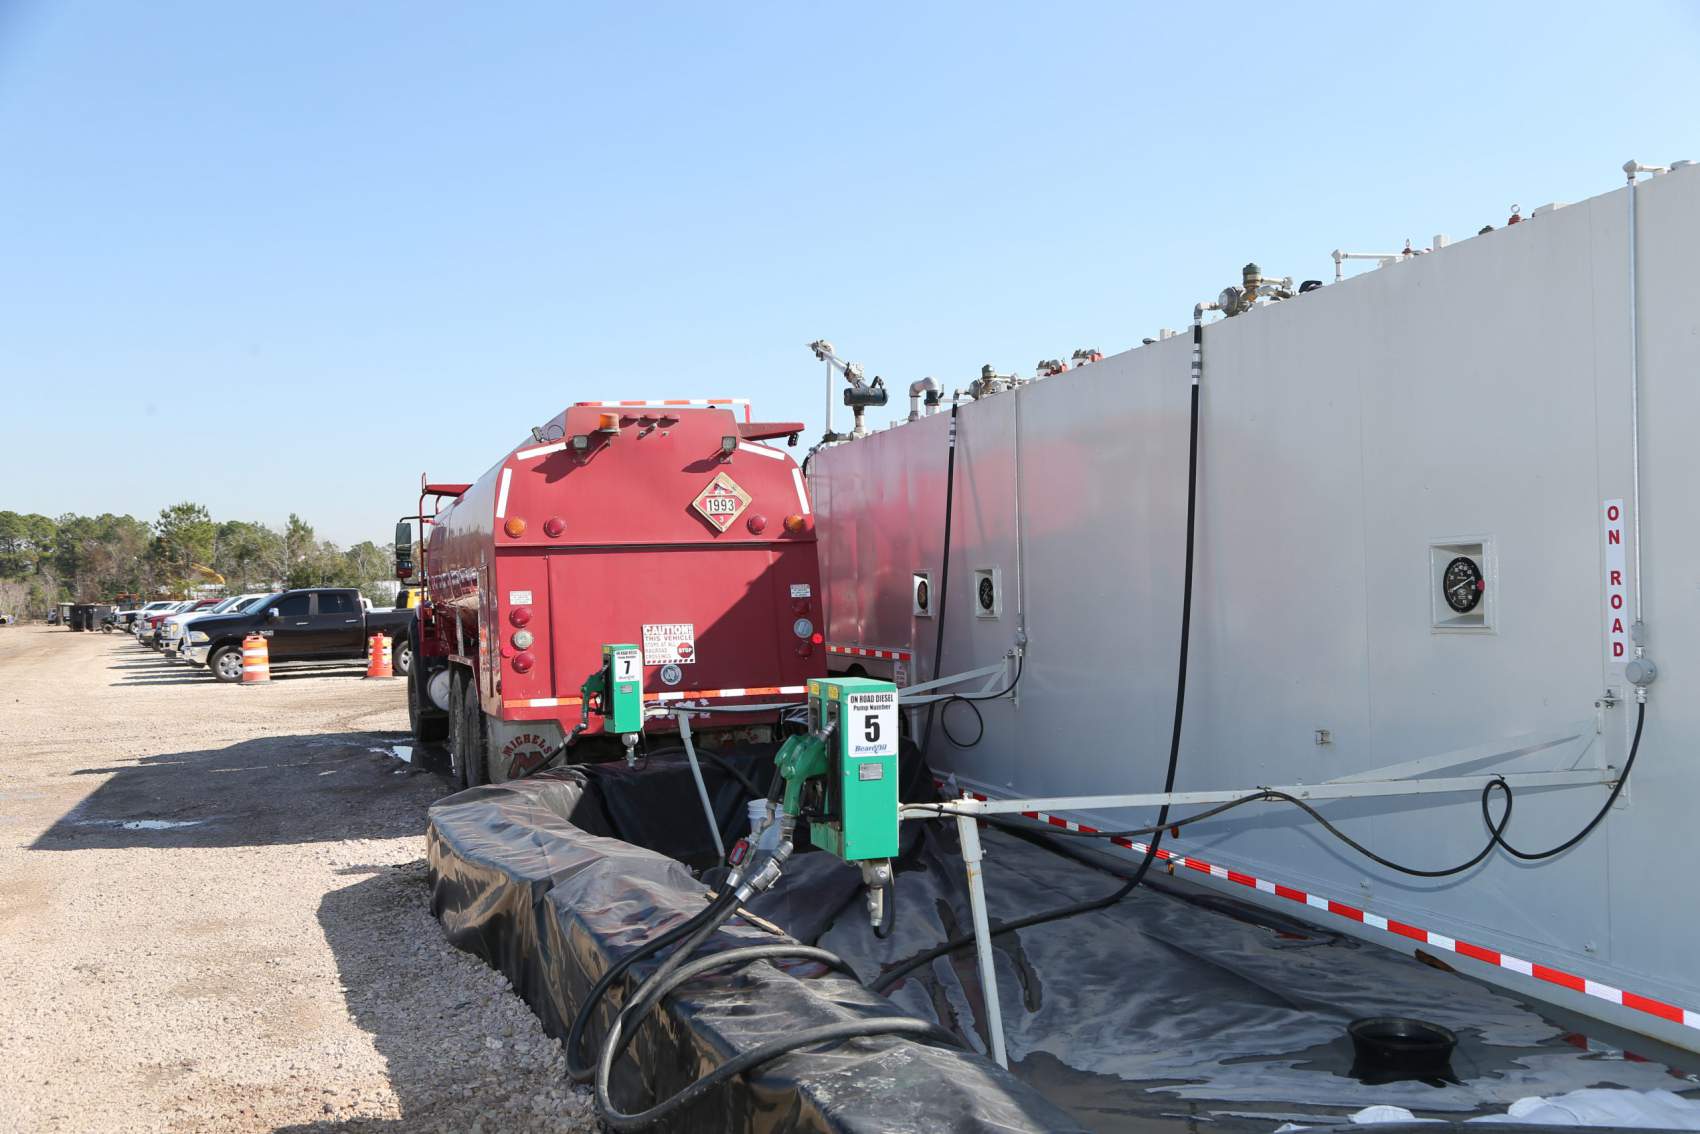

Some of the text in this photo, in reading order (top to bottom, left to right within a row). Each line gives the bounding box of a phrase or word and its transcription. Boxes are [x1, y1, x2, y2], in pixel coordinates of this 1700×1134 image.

[708, 499, 734, 511] 1993
[1607, 505, 1624, 657] ON ROAD
[624, 660, 631, 675] 7
[850, 694, 894, 703] ON ROAD DIESEL
[865, 715, 880, 742] 5
[502, 733, 553, 760] MICHELS
